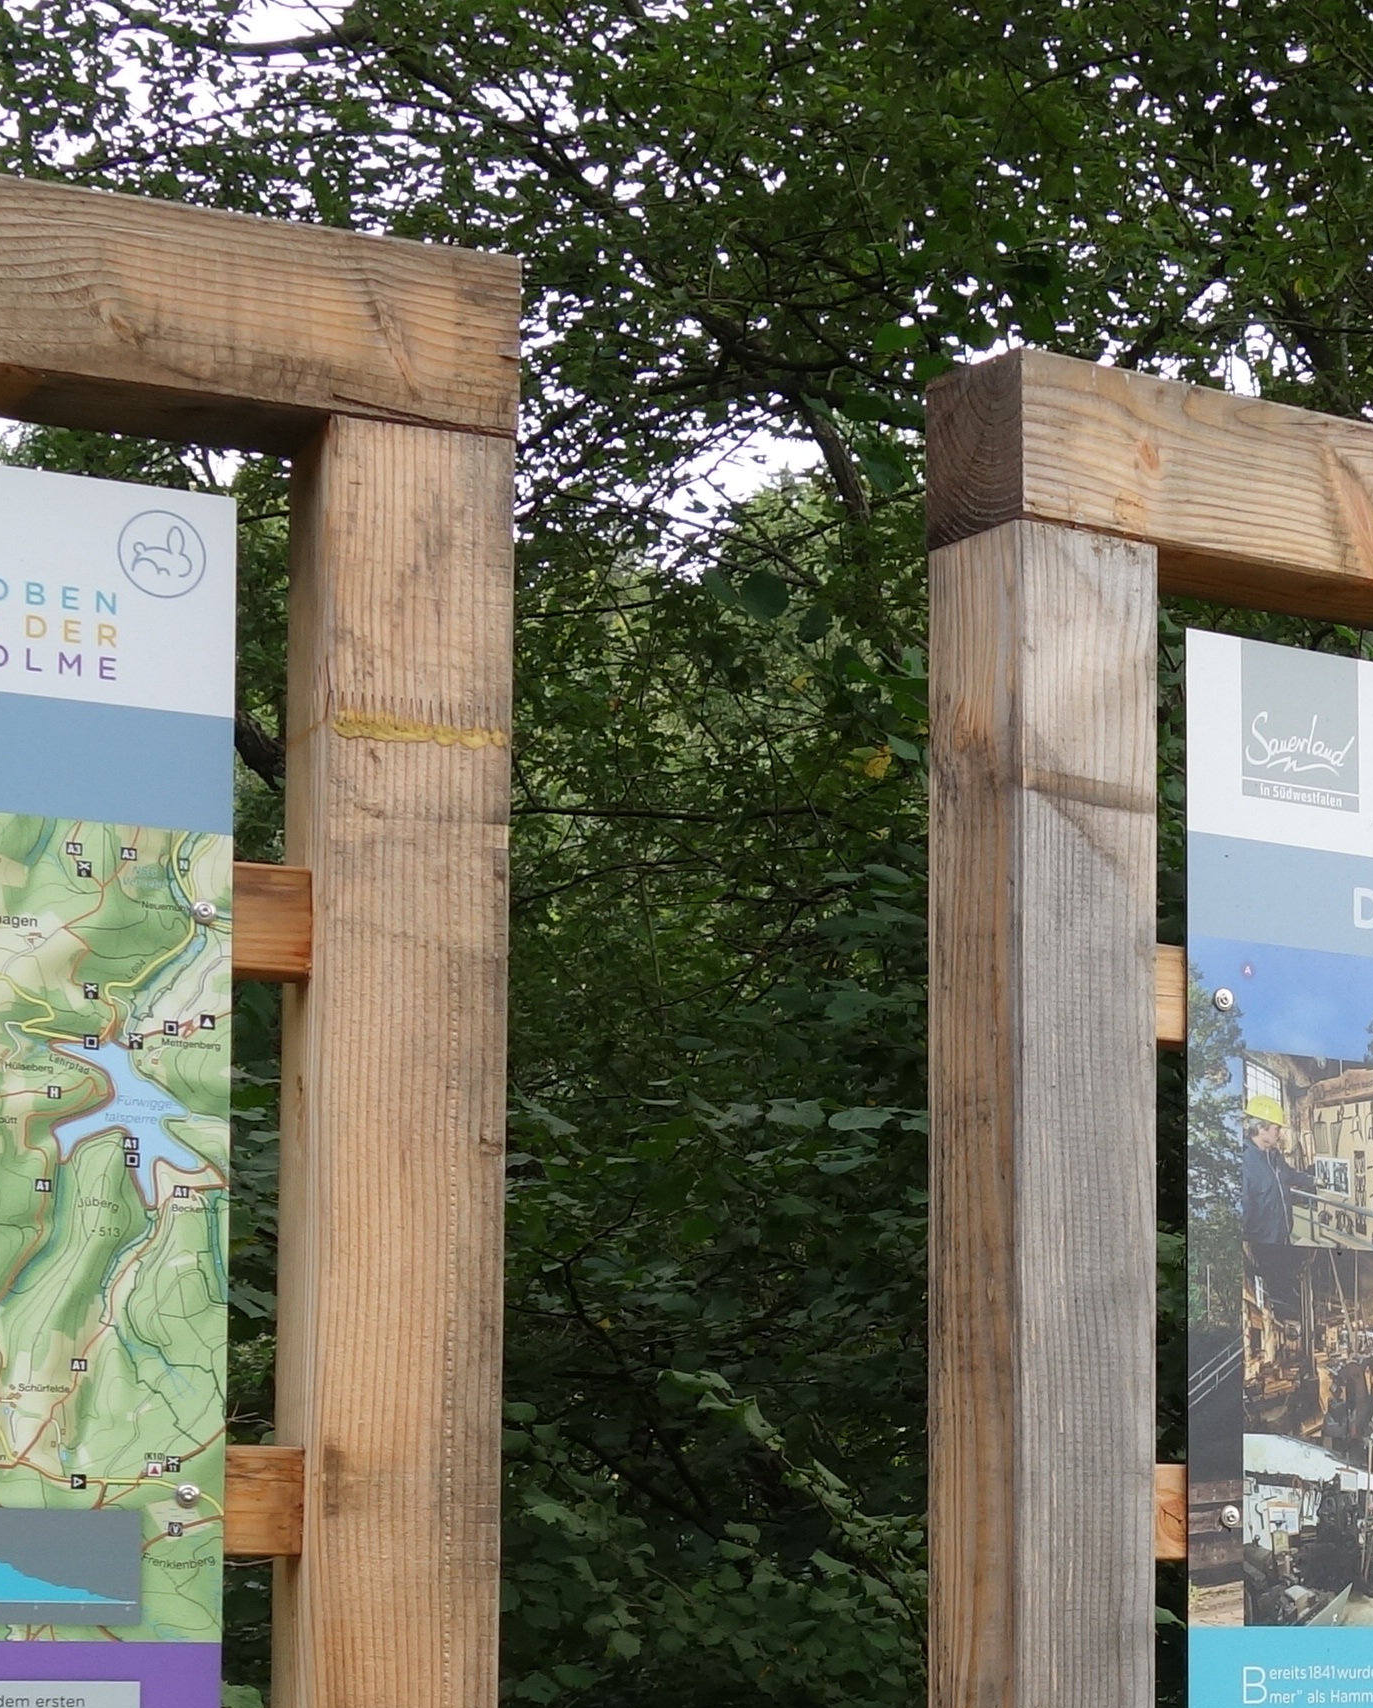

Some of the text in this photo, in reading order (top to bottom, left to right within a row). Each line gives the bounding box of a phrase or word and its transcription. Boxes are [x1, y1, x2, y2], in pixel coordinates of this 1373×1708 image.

[26, 615, 117, 648] DER
[1246, 711, 1355, 766] Sauerland
[1260, 783, 1342, 808] in Südwestfalen
[98, 1226, 120, 1238] 513
[1243, 1665, 1307, 1704] Bereits
[1308, 1666, 1335, 1679] 1841
[1308, 1689, 1325, 1703] als
[36, 1696, 85, 1707] ersten
